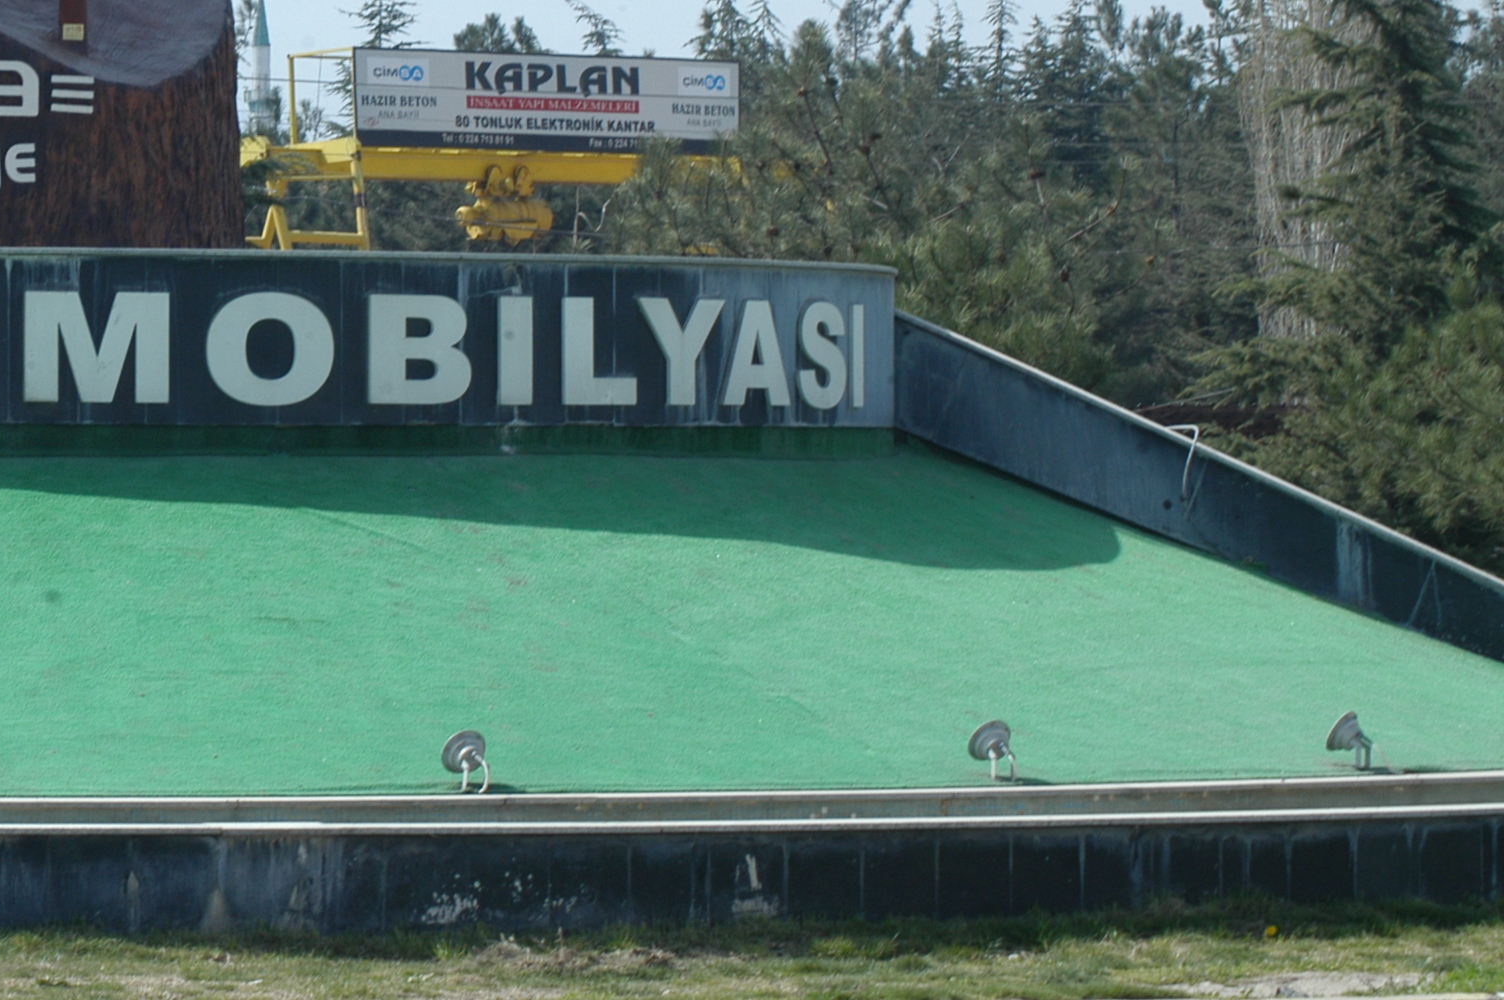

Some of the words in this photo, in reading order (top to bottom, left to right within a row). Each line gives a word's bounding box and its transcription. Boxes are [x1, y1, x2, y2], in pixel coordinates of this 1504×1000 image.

[464, 60, 640, 98] KAPLAN
[361, 94, 398, 107] HAZIR
[400, 95, 438, 107] BETON
[518, 99, 545, 110] YAPI
[548, 100, 636, 112] MALZEMELERİ
[378, 110, 395, 119] ANA
[672, 102, 702, 115] HAZIR
[704, 104, 736, 117] BETON
[455, 115, 470, 128] 80
[474, 116, 522, 130] TONLUK
[526, 116, 603, 132] ELEKTRONİK
[607, 120, 655, 133] KANTAR
[442, 134, 454, 143] Tel
[465, 135, 479, 144] 224
[589, 138, 602, 147] Fax
[614, 138, 628, 148] 224
[23, 291, 865, 409] MOBILYASI
